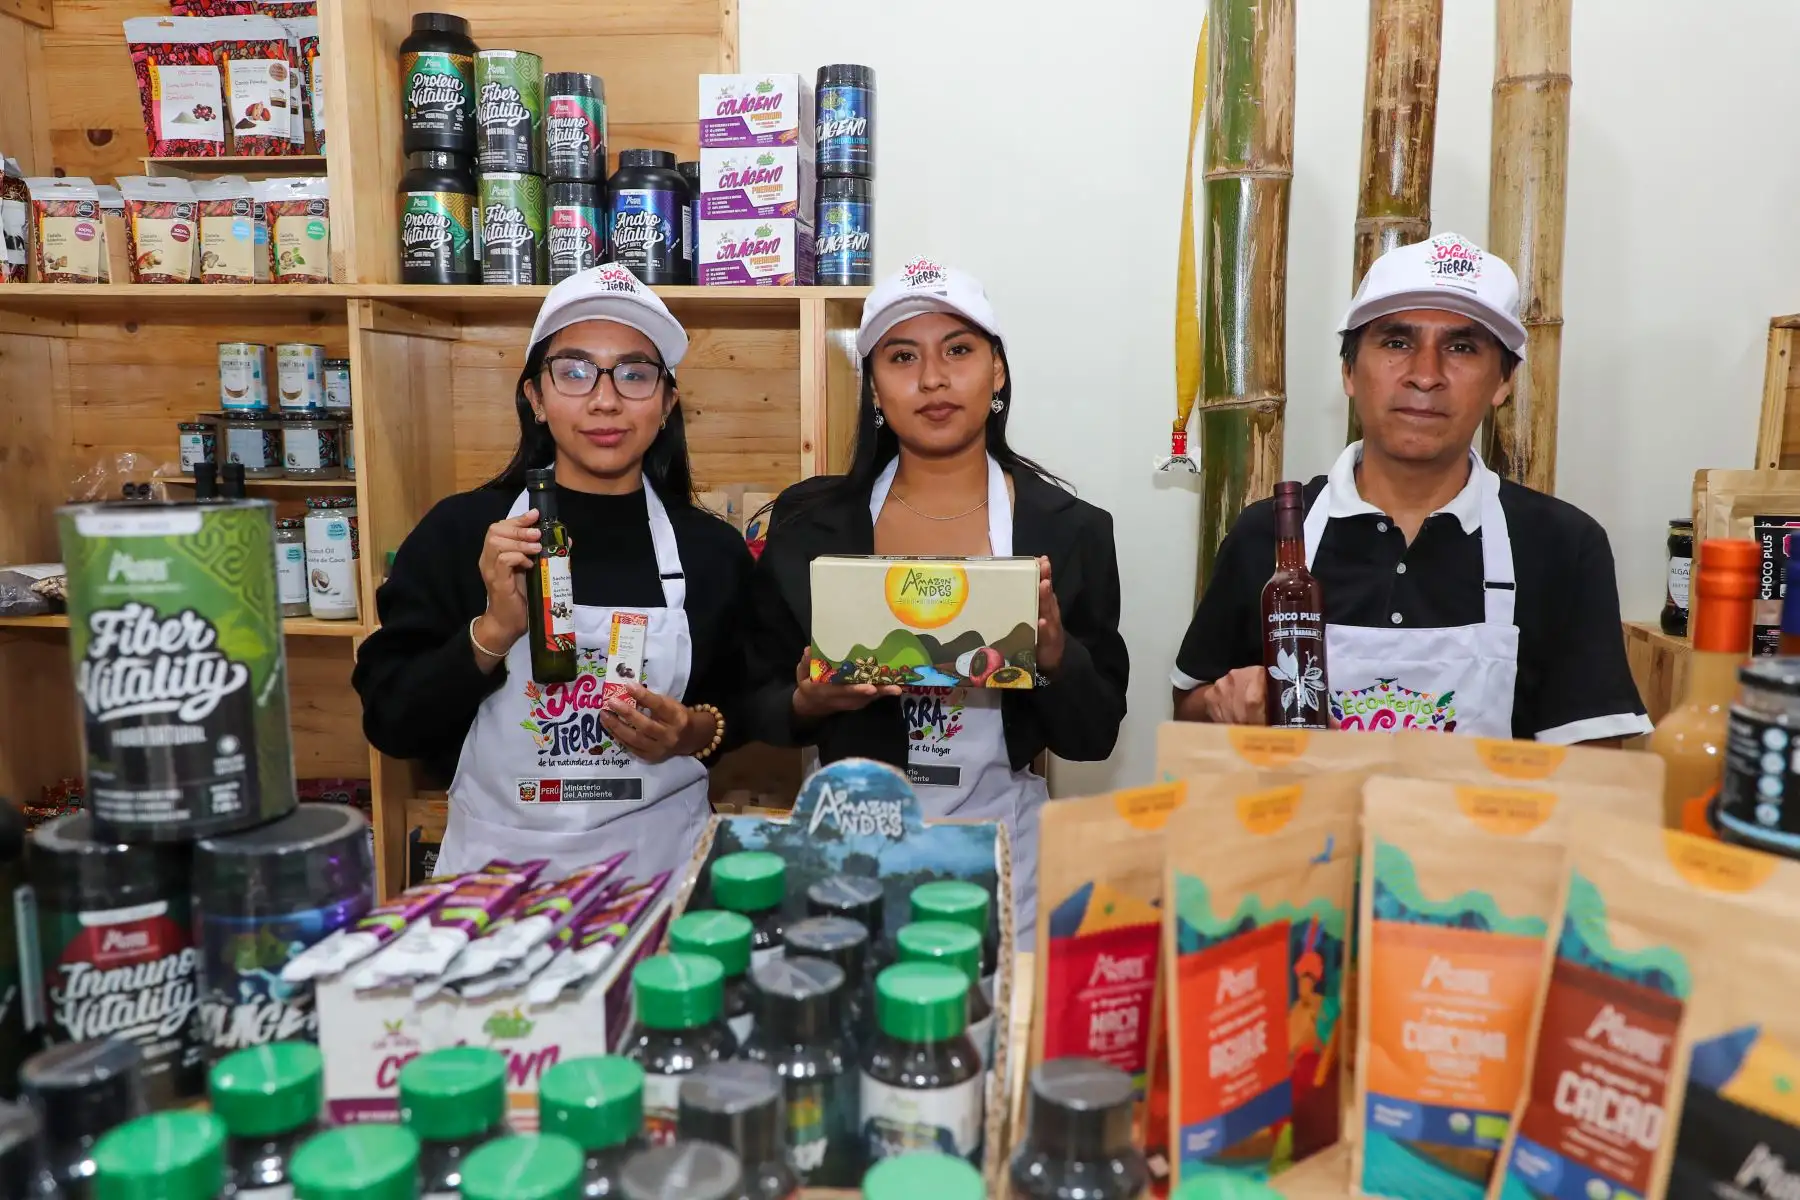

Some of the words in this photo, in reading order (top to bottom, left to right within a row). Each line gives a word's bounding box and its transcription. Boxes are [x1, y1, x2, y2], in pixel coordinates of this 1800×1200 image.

[412, 73, 464, 91] Protein
[481, 82, 519, 103] Fiber
[408, 87, 466, 112] Vitality
[716, 93, 783, 116] COLÁGENO
[477, 102, 530, 128] Vitality
[546, 127, 590, 149] Vitality
[718, 165, 784, 189] COLÁGENO
[404, 212, 450, 229] Protein
[485, 204, 523, 223] Fiber
[616, 210, 661, 228] Andro
[402, 226, 452, 249] Vitality
[481, 222, 534, 248] Vitality
[548, 225, 591, 240] Inmuno
[612, 226, 664, 250] Vitality
[548, 237, 593, 258] Vitality
[716, 237, 781, 260] COLÁGENO
[1437, 244, 1477, 261] Madre
[1763, 534, 1773, 559] PLUS
[1761, 561, 1773, 600] CHOCO
[1268, 612, 1299, 623] CHOCO
[1300, 612, 1321, 621] PLUS
[88, 602, 215, 657] Fiber
[76, 652, 248, 722] Vitality
[1341, 692, 1435, 715] Eco-Feria
[922, 743, 930, 752] tu
[931, 743, 951, 757] hogar
[538, 758, 547, 766] de
[548, 757, 556, 766] la
[602, 758, 610, 766] tu
[611, 757, 630, 769] hogar
[540, 784, 559, 795] PERÚ
[577, 790, 613, 798] Ambiente
[55, 948, 197, 1002] Inmuno
[52, 980, 200, 1042] Vitality
[1553, 1070, 1665, 1151] CACAO
